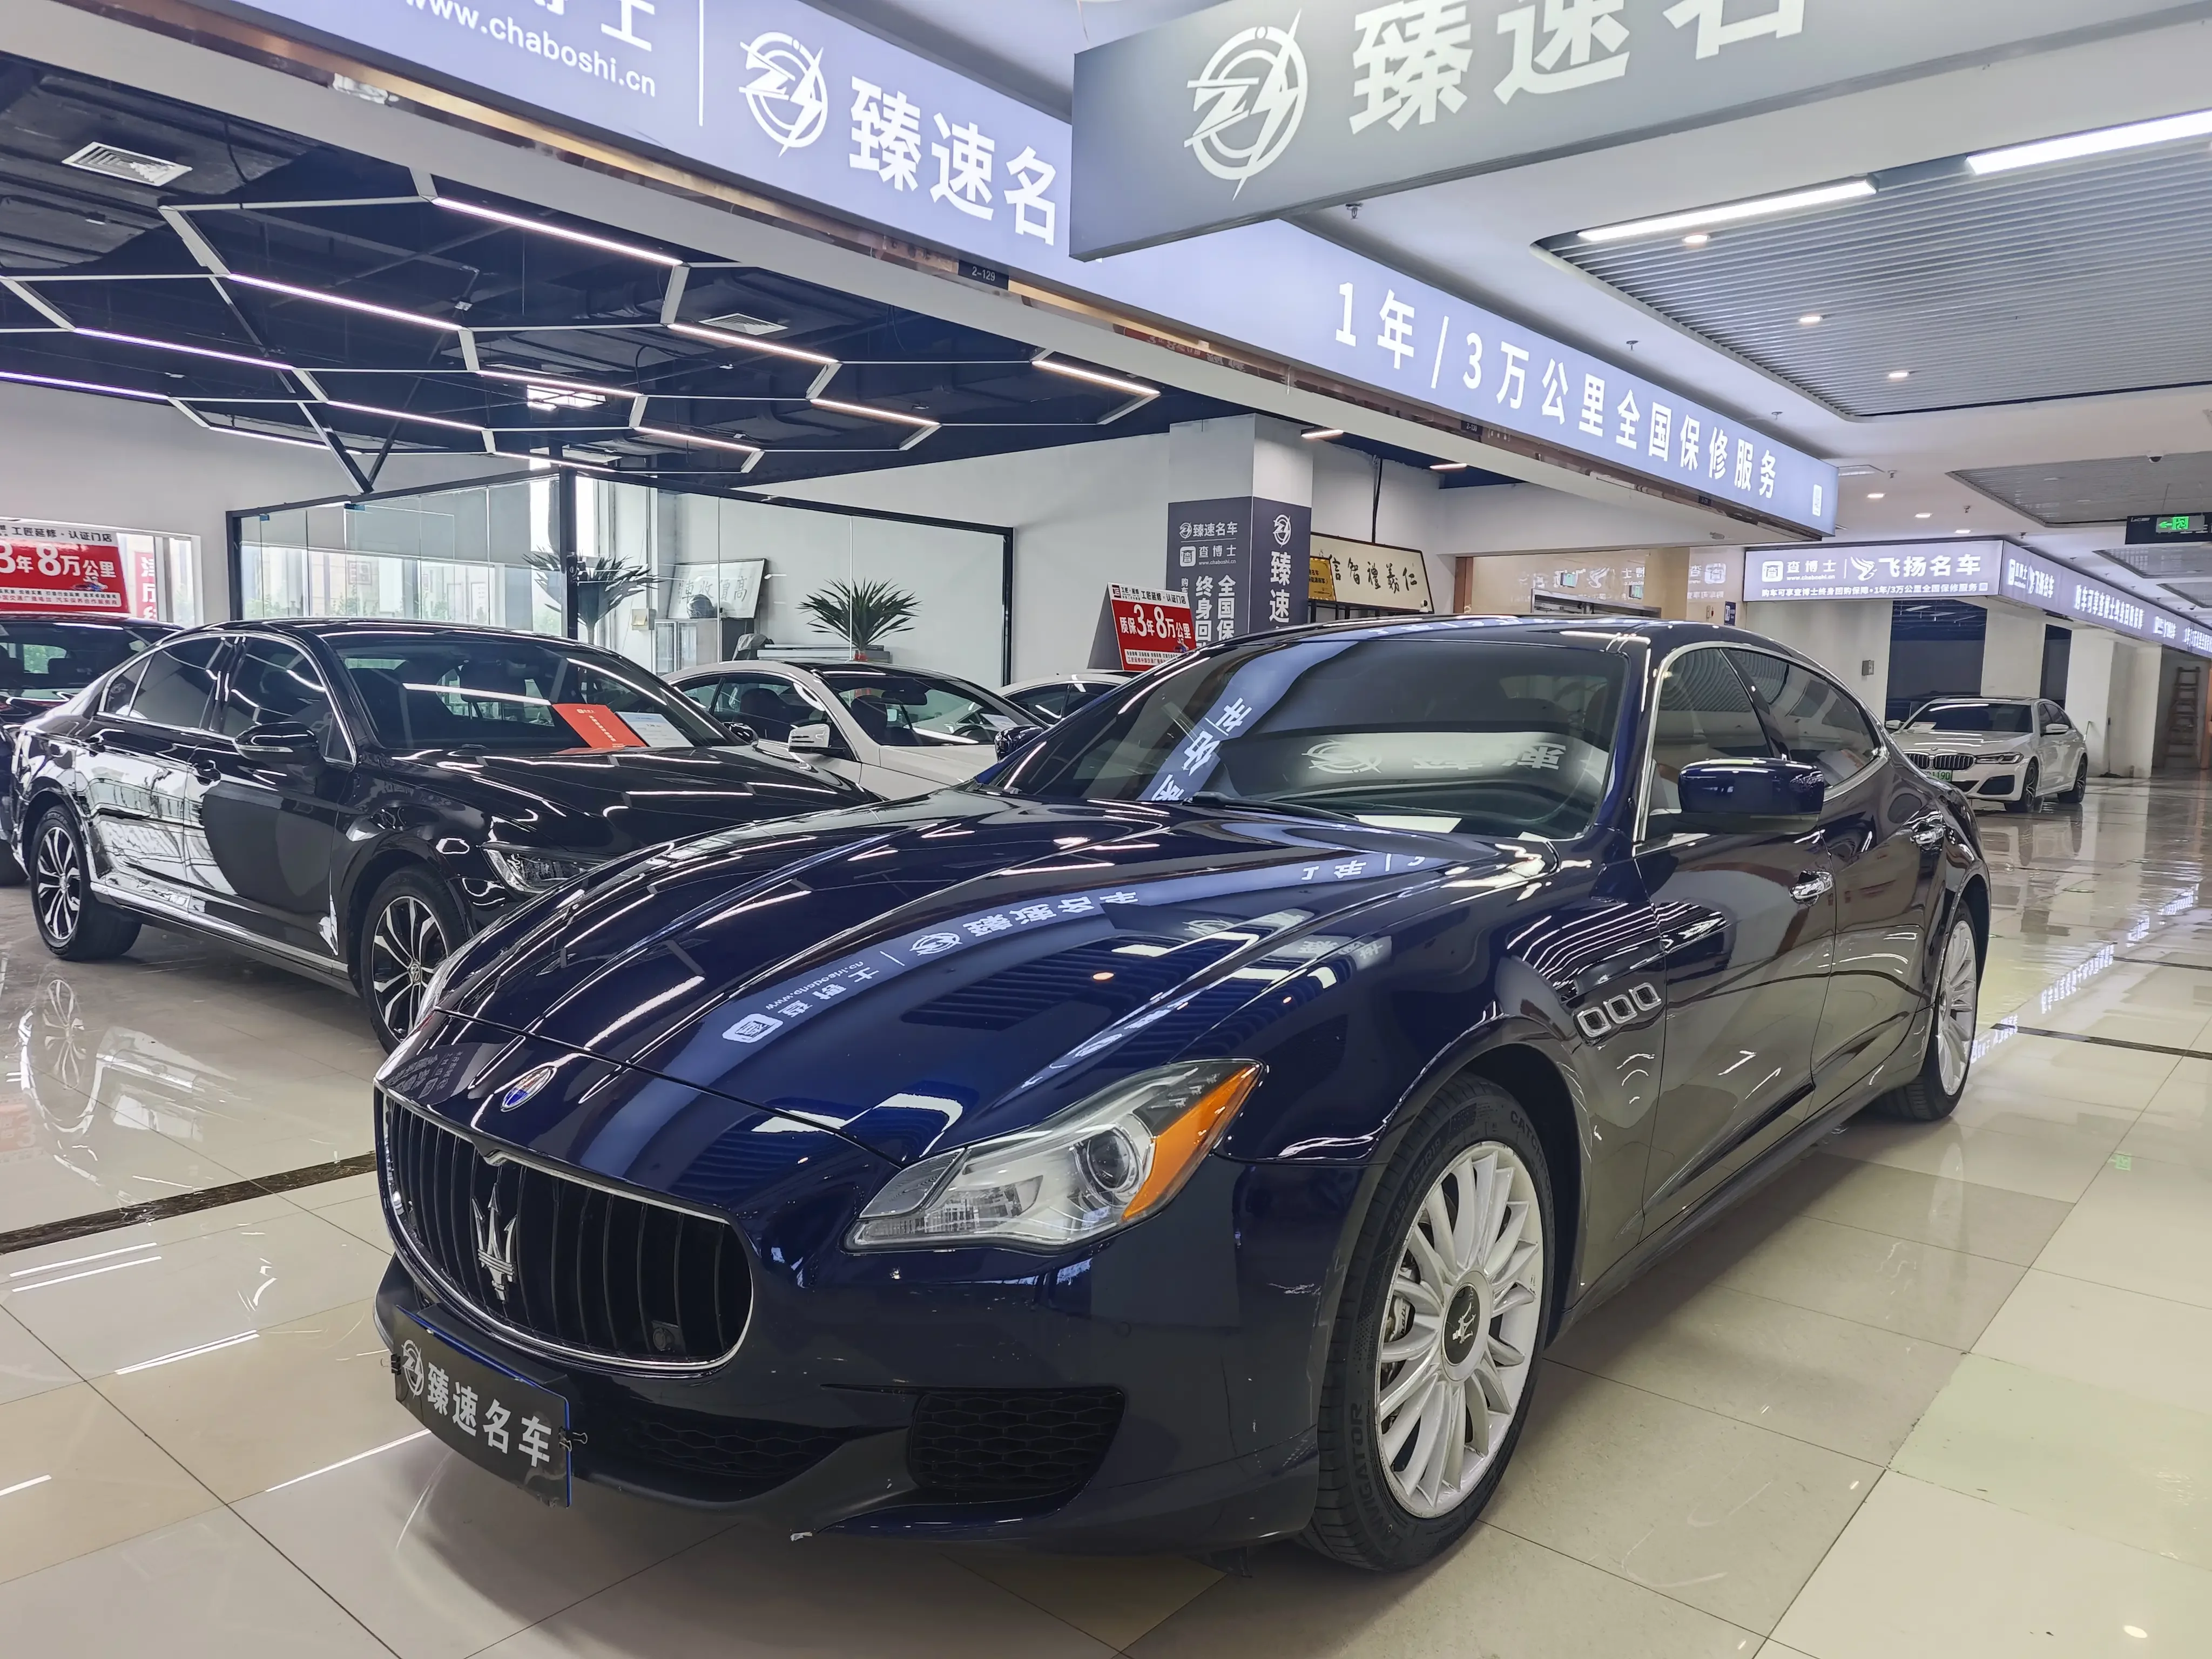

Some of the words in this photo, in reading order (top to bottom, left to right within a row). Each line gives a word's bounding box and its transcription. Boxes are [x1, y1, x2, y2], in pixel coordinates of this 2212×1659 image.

[972, 266, 995, 281] 2-129
[1193, 522, 1238, 537] 臻速名车
[1199, 545, 1236, 558] 查博士
[1787, 560, 1837, 573] 查博士
[1878, 554, 1981, 578] 飞扬名车
[1119, 604, 1192, 639] 质保3年8万公里
[1195, 575, 1213, 648] 终身回
[427, 1362, 552, 1467] 臻速名车
